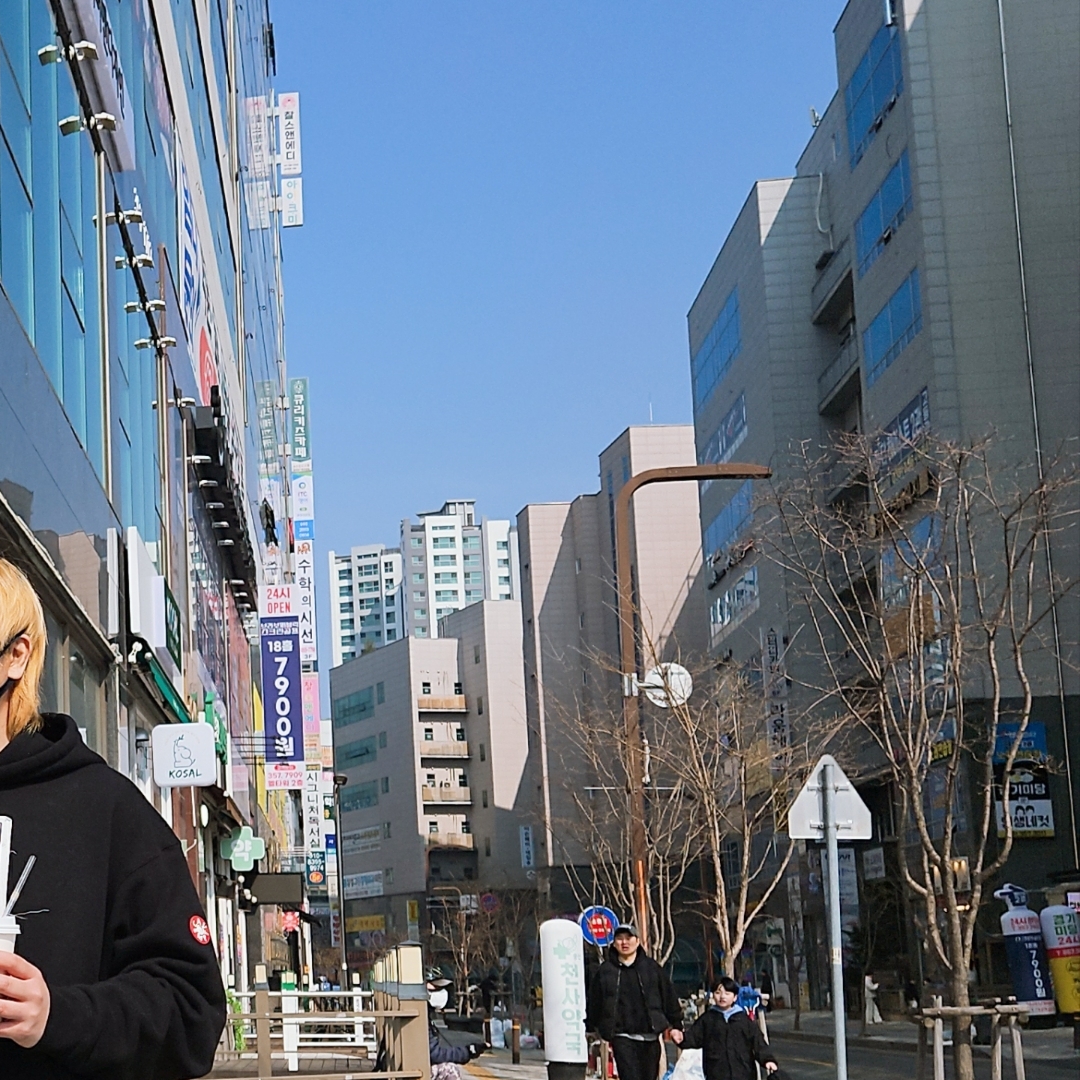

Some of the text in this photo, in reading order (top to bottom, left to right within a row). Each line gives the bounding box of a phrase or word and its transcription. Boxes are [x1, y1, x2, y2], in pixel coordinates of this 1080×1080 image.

[285, 111, 295, 160] 찰스앤에디
[294, 394, 307, 457] 큐리키즈카페
[266, 587, 290, 600] 24시
[298, 559, 313, 644] 수학의시선
[267, 602, 291, 614] OPEN
[267, 640, 293, 653] 18홀
[168, 768, 202, 779] KOSAL
[230, 839, 253, 862] 약
[561, 962, 582, 1056] 천사약국
